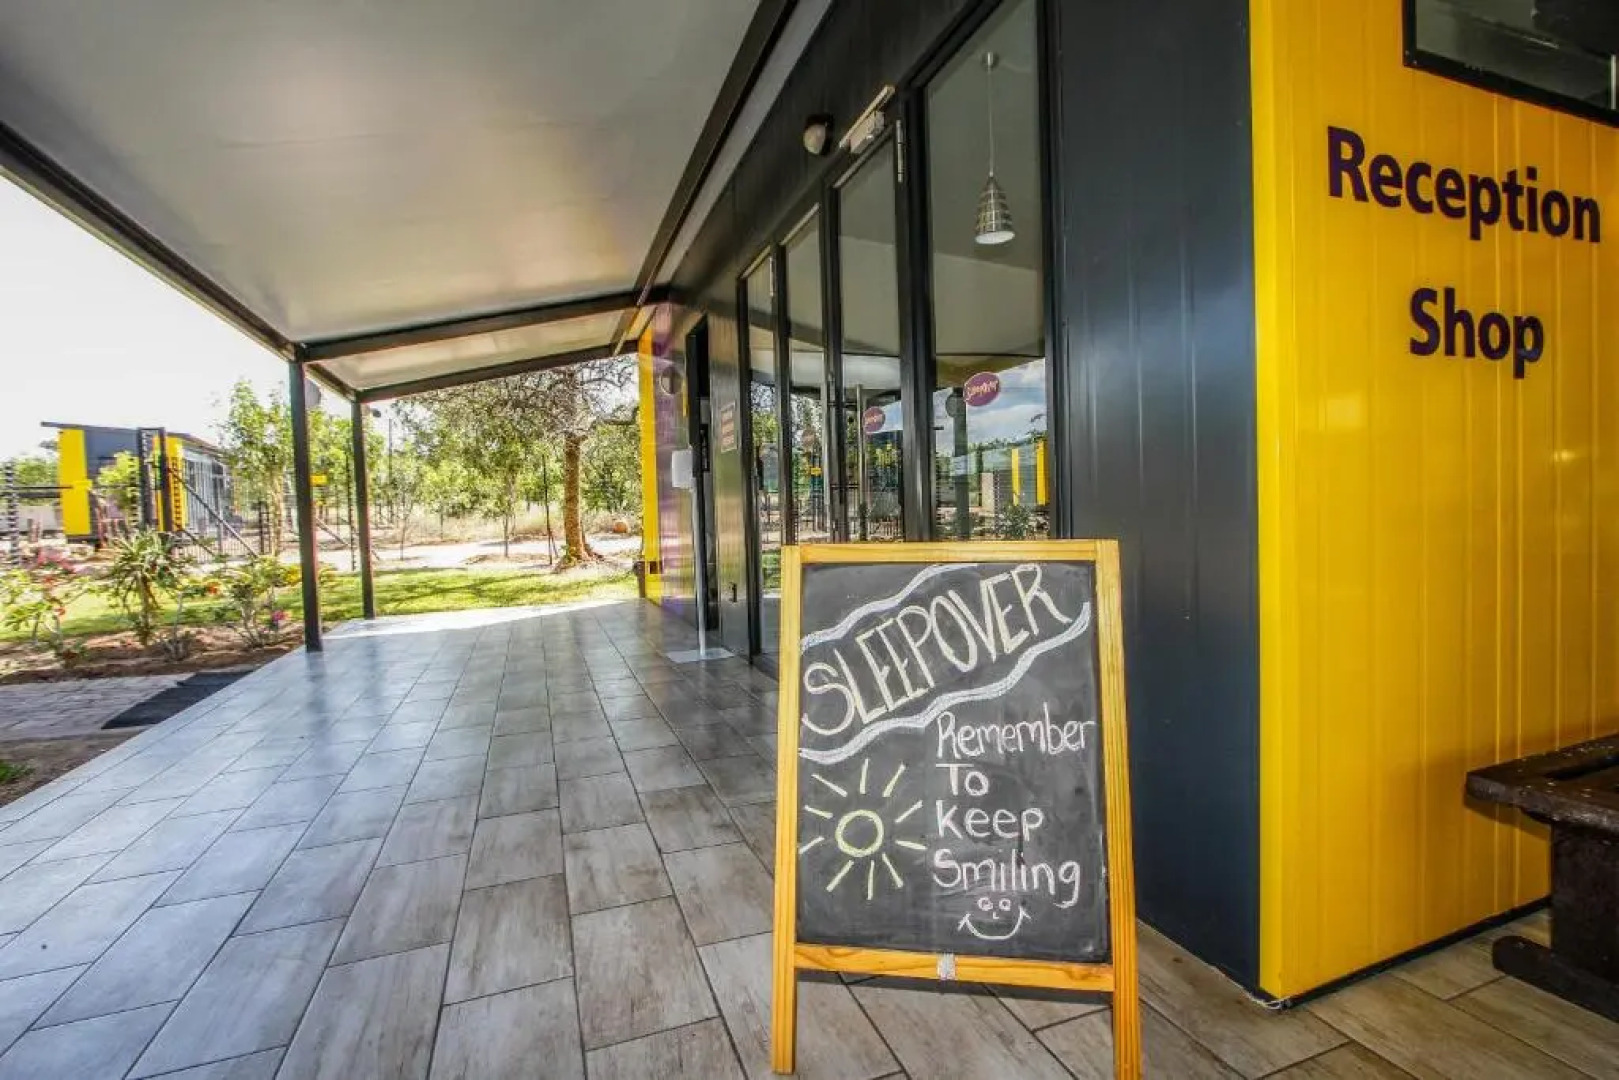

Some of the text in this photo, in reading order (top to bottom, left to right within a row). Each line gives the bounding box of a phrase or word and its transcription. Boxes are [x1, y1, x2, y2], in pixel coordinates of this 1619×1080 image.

[1327, 125, 1600, 243] Reception
[1409, 286, 1544, 379] Shop
[801, 563, 1073, 735] SLEEPOVER
[936, 702, 1096, 759] Remember
[936, 763, 989, 795] To
[933, 849, 1081, 908] Smiling
